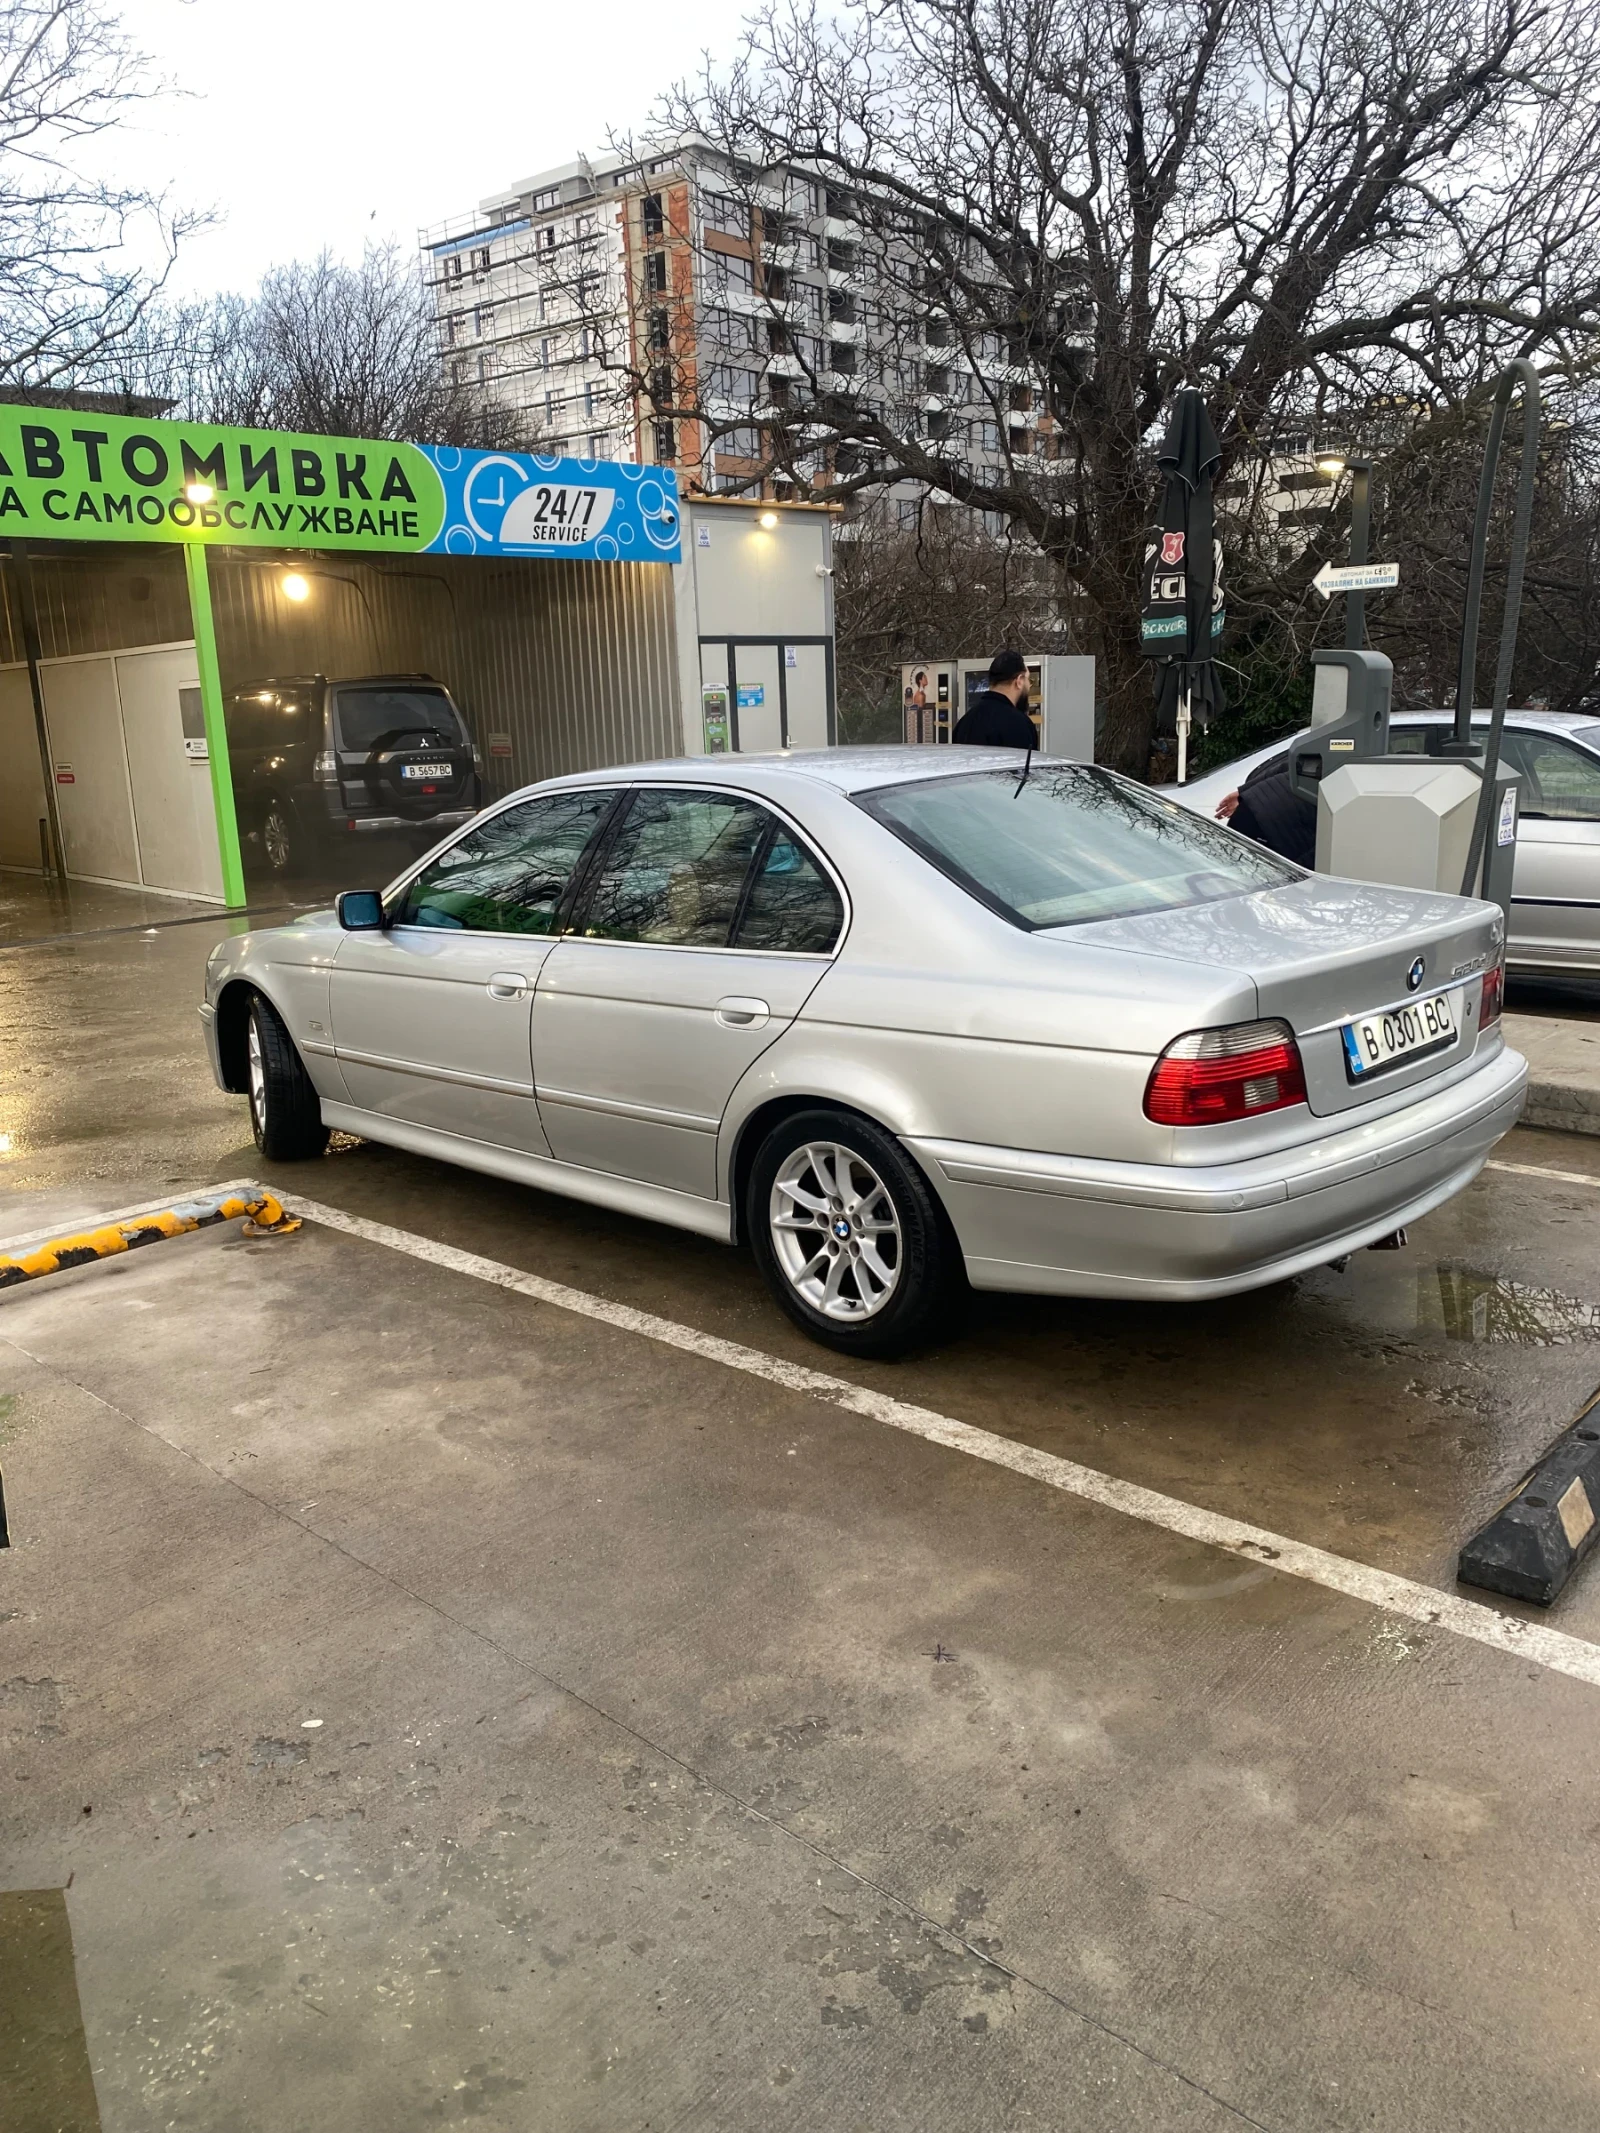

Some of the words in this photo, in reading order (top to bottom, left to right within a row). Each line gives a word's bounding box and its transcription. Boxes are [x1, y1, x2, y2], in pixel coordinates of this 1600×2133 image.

[42, 489, 420, 538] САМООБСЛУЖВАНЕ
[533, 487, 597, 525] 24/7
[532, 525, 588, 542] SERVICE
[1320, 578, 1354, 589] РАЗВАЛЯНЕ
[1354, 578, 1363, 586] НА
[1364, 575, 1396, 585] БАНКНОТИ
[418, 765, 438, 776] 5657
[1383, 1006, 1425, 1052] 0301
